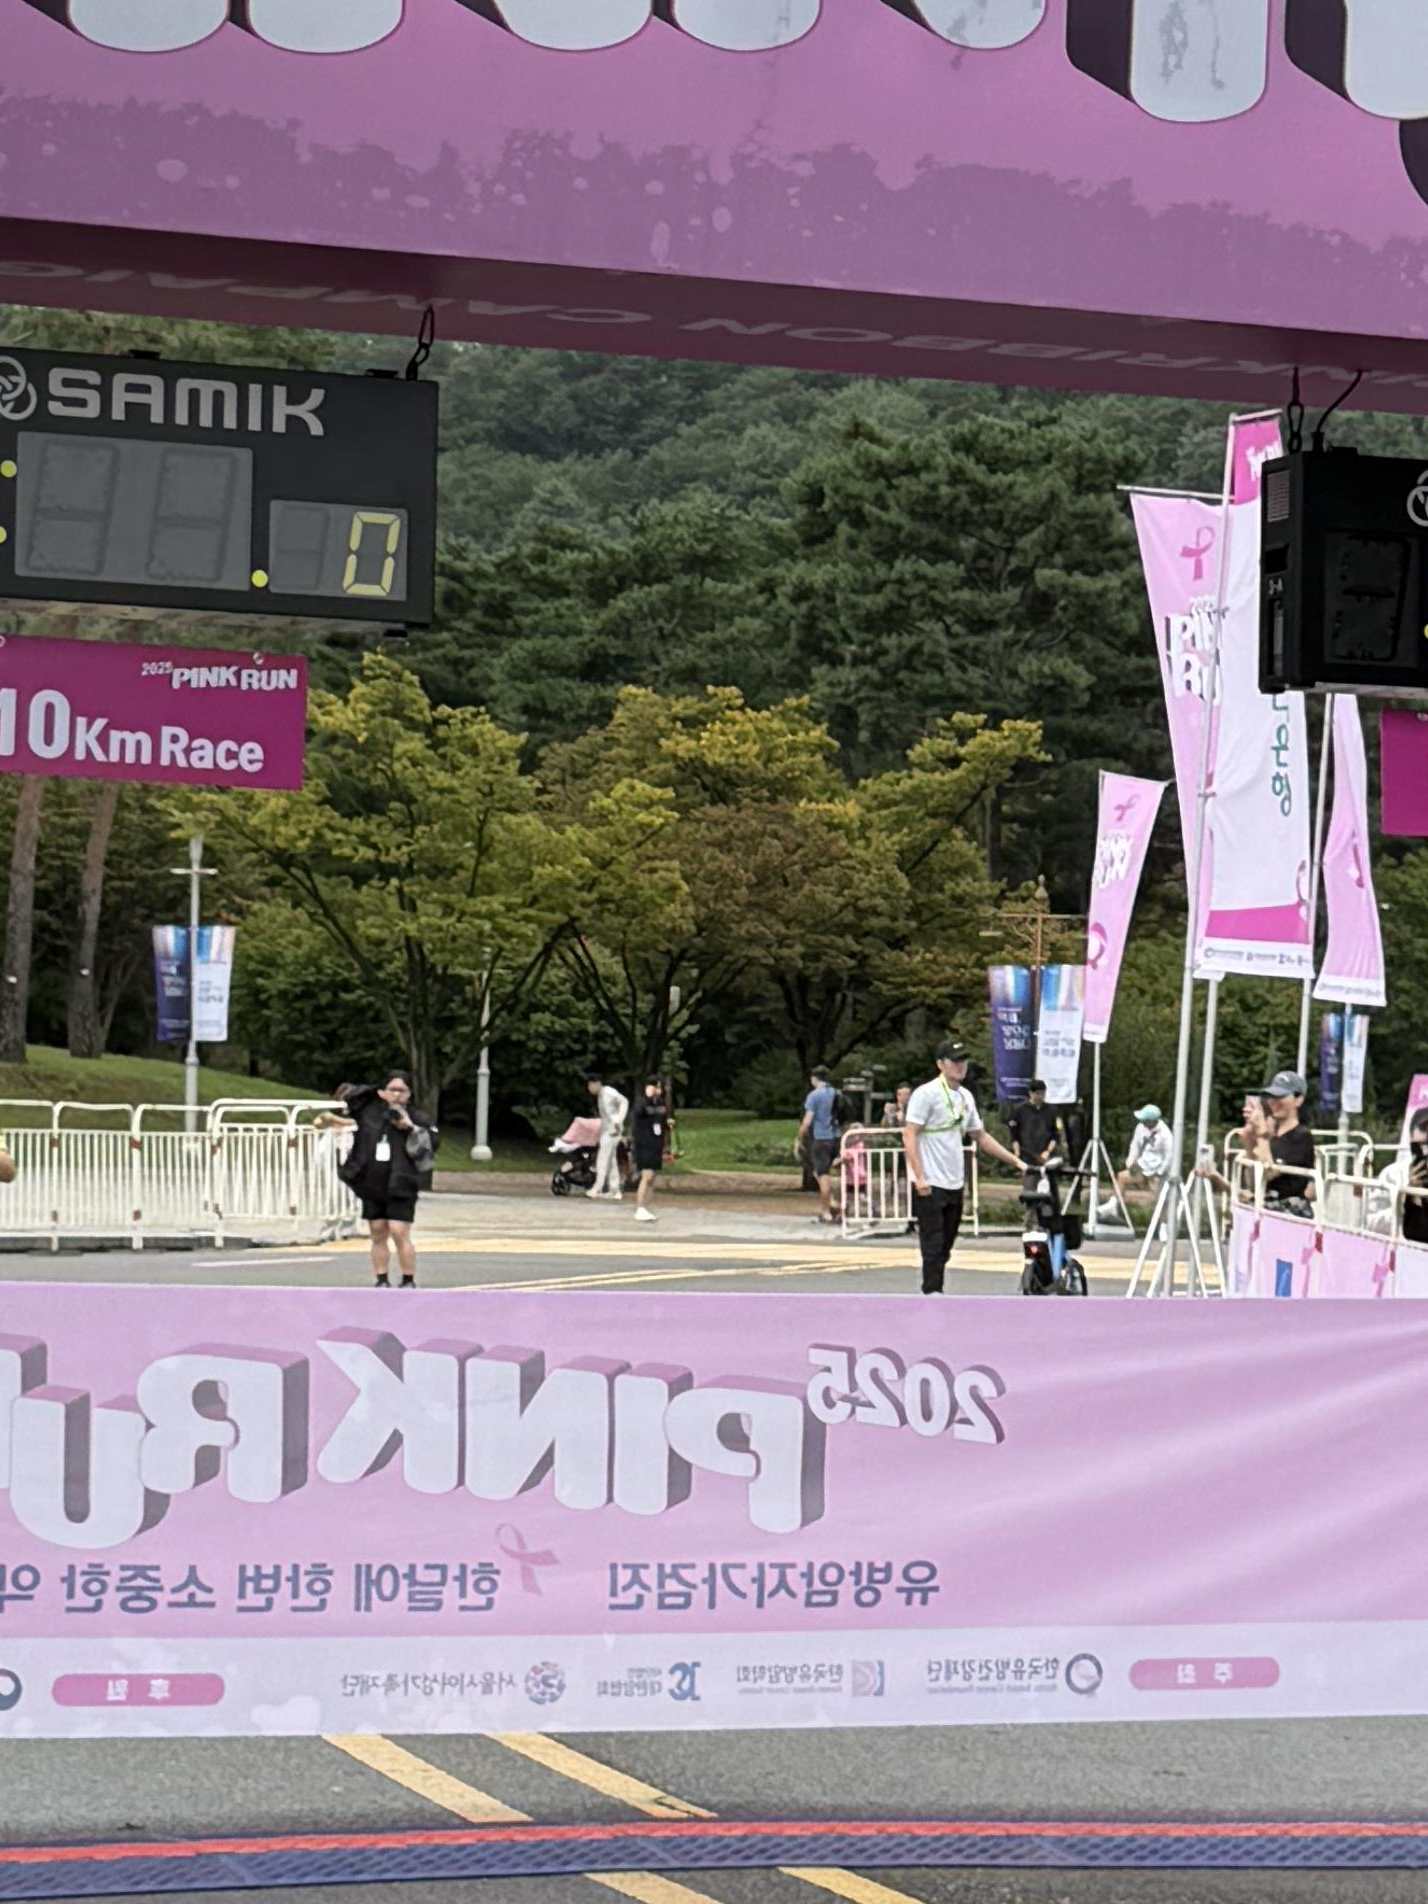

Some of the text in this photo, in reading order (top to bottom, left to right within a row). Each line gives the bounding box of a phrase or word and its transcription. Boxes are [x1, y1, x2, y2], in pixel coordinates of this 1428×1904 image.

[46, 366, 326, 438] SAMIK
[342, 510, 402, 597] 0
[172, 665, 238, 691] PINK
[240, 667, 299, 691] RUN
[160, 724, 264, 774] Race
